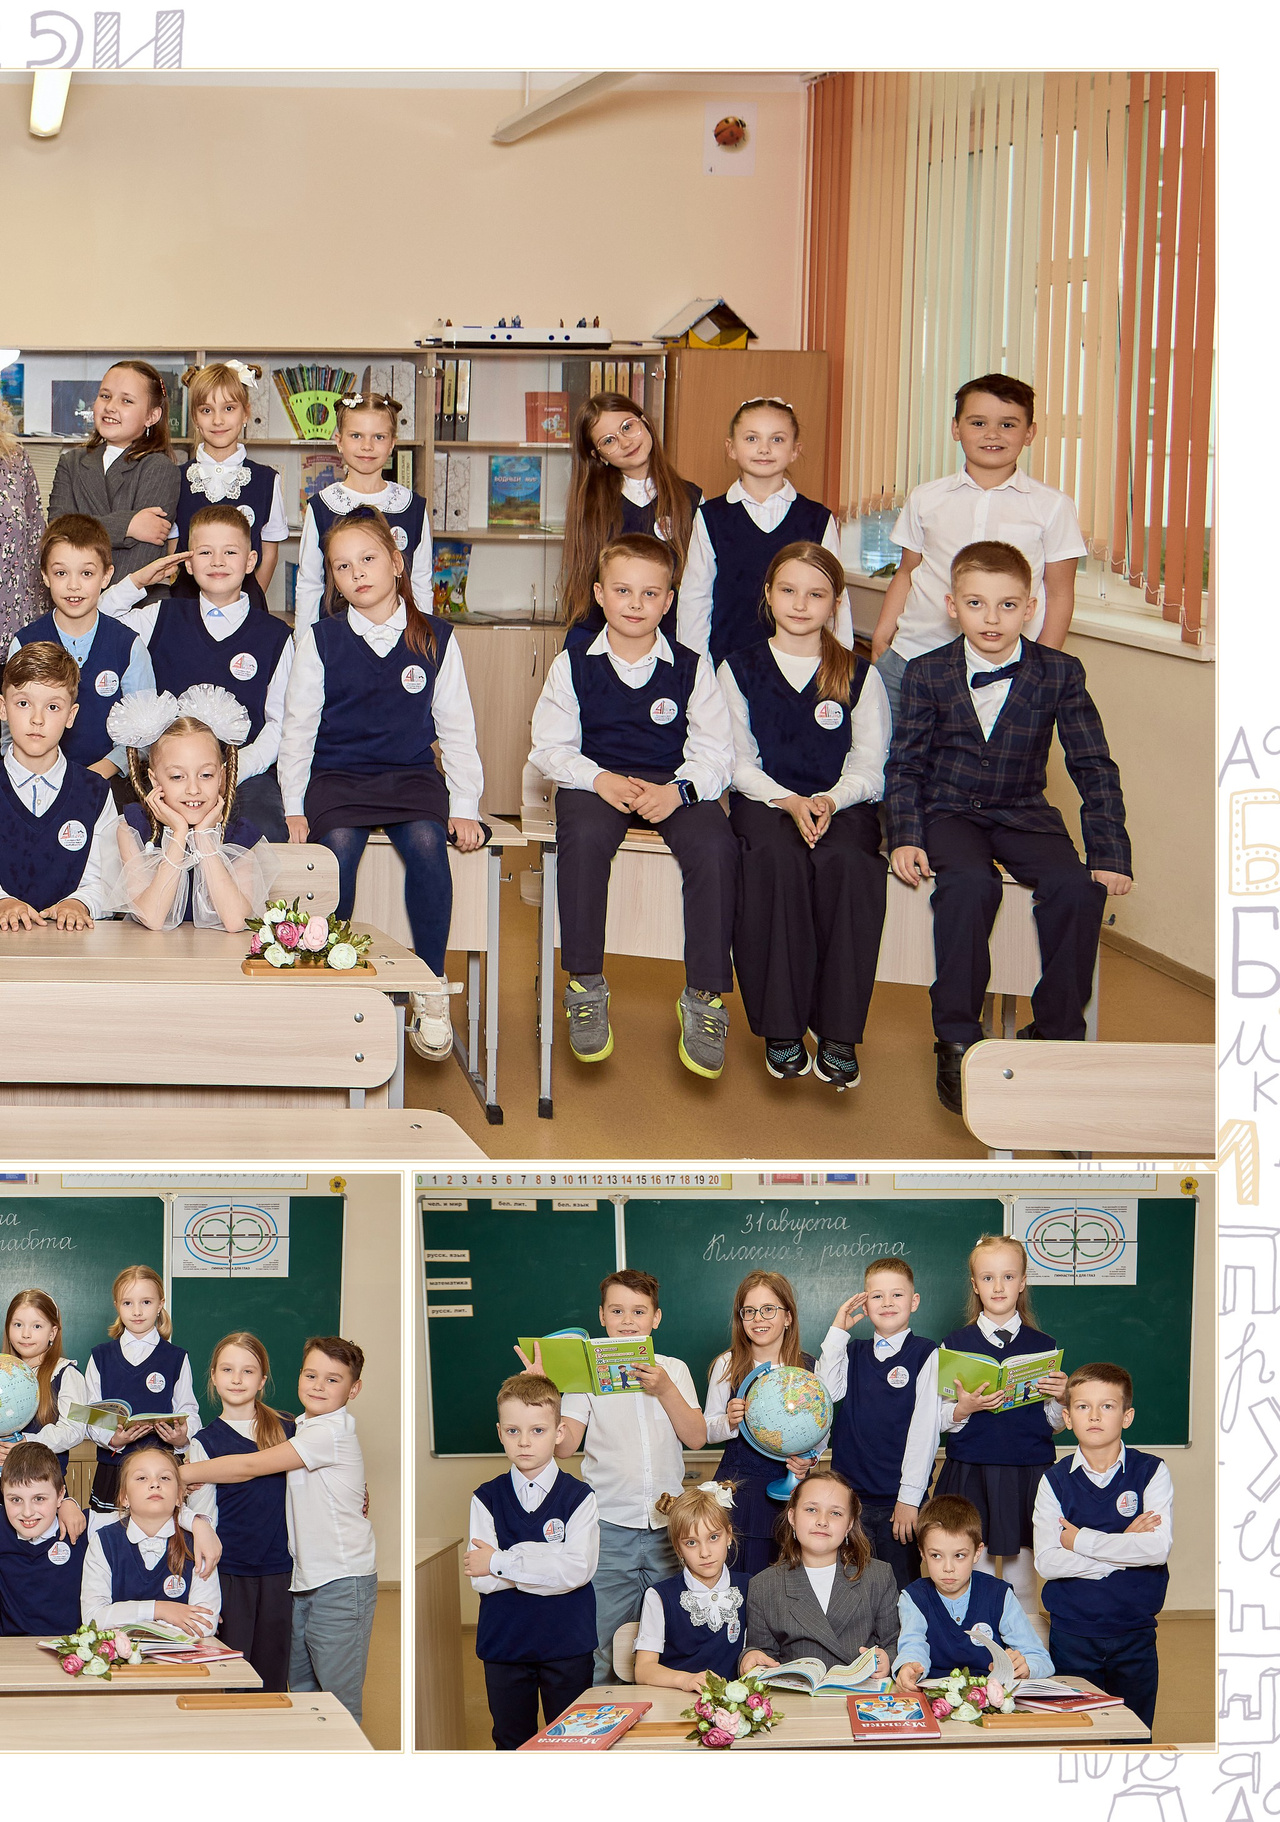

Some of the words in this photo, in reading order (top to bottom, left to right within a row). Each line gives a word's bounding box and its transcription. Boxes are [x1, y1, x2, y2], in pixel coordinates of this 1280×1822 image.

[418, 1175, 423, 1184] 0
[432, 1175, 437, 1184] 1
[448, 1175, 453, 1184] 2
[462, 1175, 468, 1184] 3
[476, 1175, 482, 1184] 4
[492, 1175, 498, 1184] 5
[506, 1175, 512, 1184] 6
[522, 1175, 526, 1184] 7
[536, 1175, 542, 1184] 8
[550, 1175, 556, 1184] 9
[564, 1175, 574, 1184] 10
[578, 1175, 587, 1184] 11
[594, 1175, 603, 1184] 12
[608, 1175, 618, 1184] 13
[622, 1175, 632, 1184] 14
[638, 1175, 647, 1184] 15
[652, 1175, 662, 1184] 16
[666, 1175, 675, 1184] 17
[680, 1175, 690, 1184] 18
[696, 1175, 705, 1184] 19
[708, 1175, 719, 1184] 20
[741, 1212, 764, 1234] 31
[766, 1208, 850, 1244] августа
[818, 1233, 911, 1271] работа
[638, 1346, 648, 1355] 2
[1048, 1360, 1056, 1368] 2
[537, 1737, 599, 1745] Музыка
